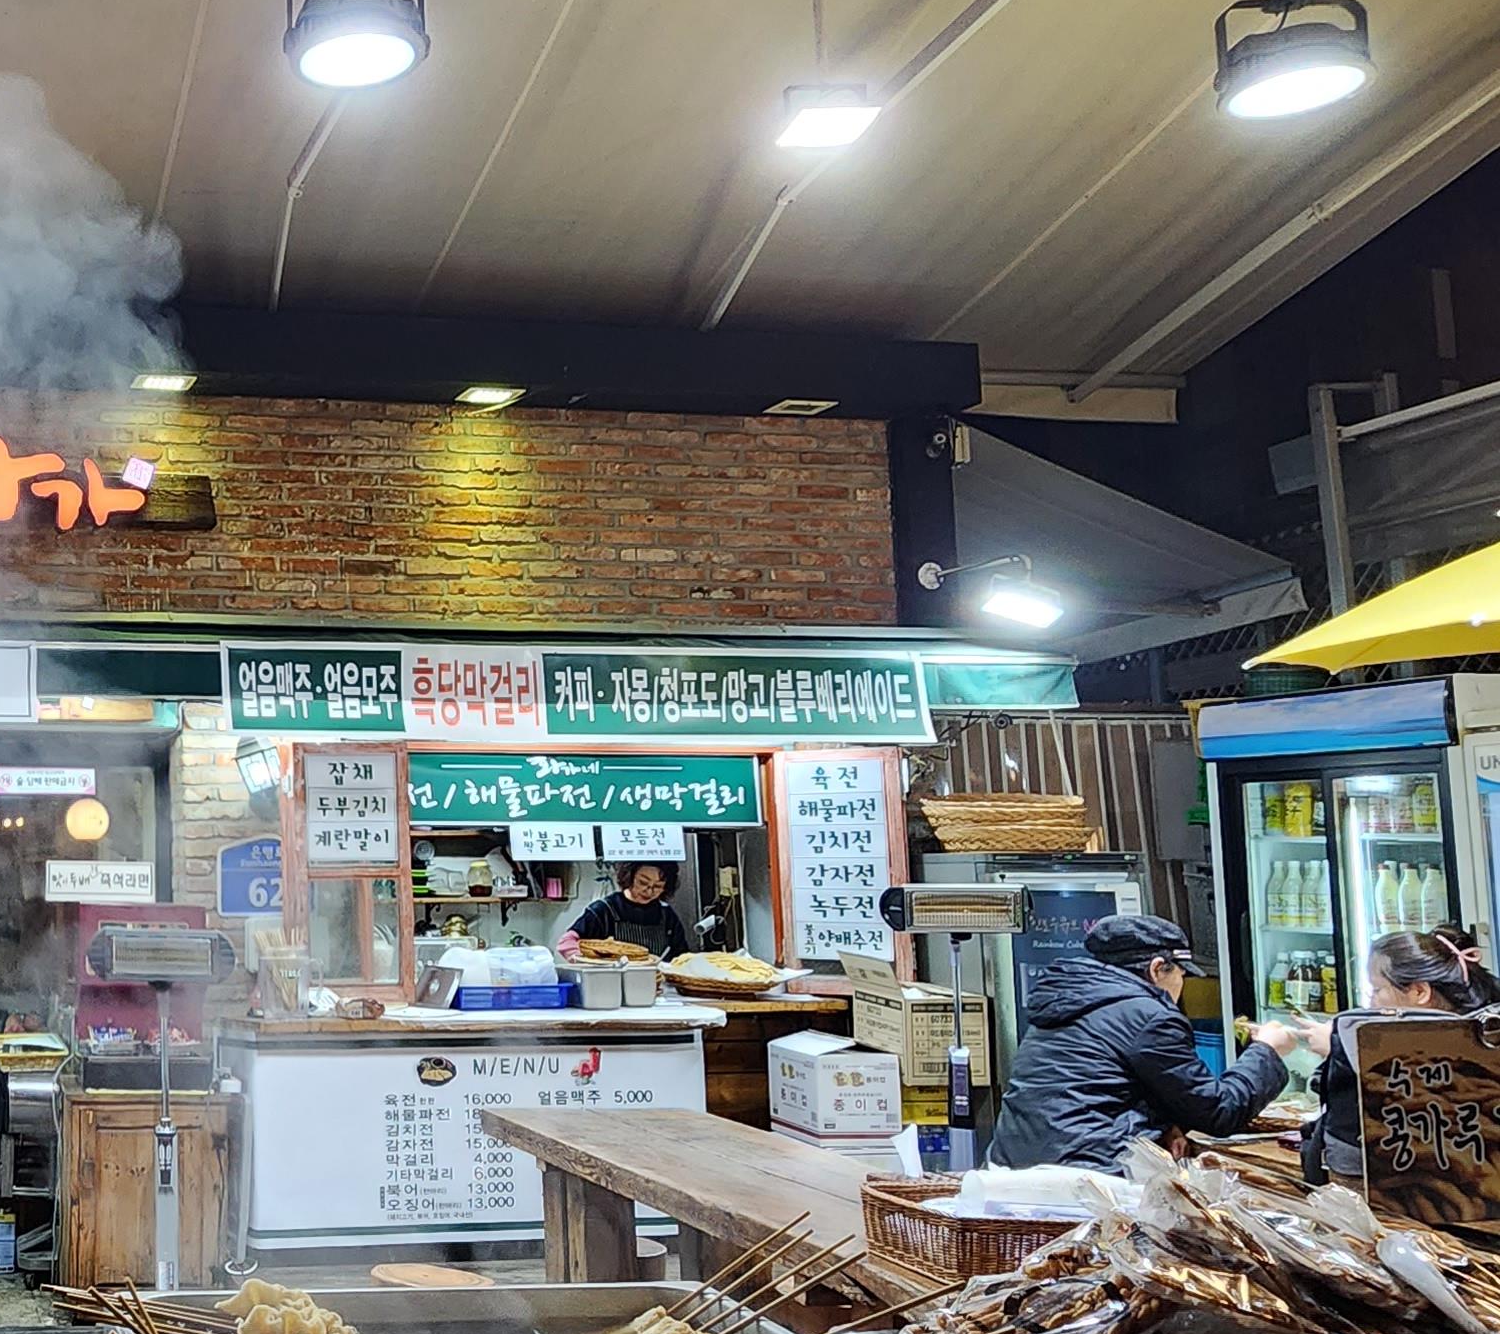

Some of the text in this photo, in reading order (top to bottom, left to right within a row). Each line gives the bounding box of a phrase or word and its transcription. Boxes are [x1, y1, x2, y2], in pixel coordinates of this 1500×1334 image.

[411, 656, 542, 727] 흑당막걸리
[327, 761, 374, 786] 잡채
[810, 766, 858, 790] 육전
[316, 796, 388, 817] 두부김치
[464, 777, 597, 818] 해물파전
[619, 779, 746, 817] 생막걸리
[798, 797, 877, 823] 해물파전
[314, 828, 390, 852] 계란말이
[535, 830, 584, 852] 불고기
[619, 827, 666, 846] 모듬전
[805, 830, 872, 853] 김치전
[805, 863, 875, 887] 감자전
[809, 894, 875, 918] 녹두전
[818, 930, 884, 951] 양배추전
[1387, 1057, 1452, 1098] 수제
[384, 1093, 417, 1107] 육전
[463, 1092, 512, 1106] 16,000
[538, 1089, 602, 1106] 얼음맥주
[614, 1089, 653, 1104] 5,000
[384, 1108, 451, 1122] 해물파전
[385, 1123, 434, 1137] 김치전
[385, 1138, 434, 1152] 감자전
[386, 1151, 513, 1166] 막걸리 4,000
[386, 1166, 514, 1182] 기타막걸리 6,000
[467, 1181, 515, 1195] 13,000
[386, 1198, 435, 1212] 오징어
[467, 1196, 515, 1210] 13,000
